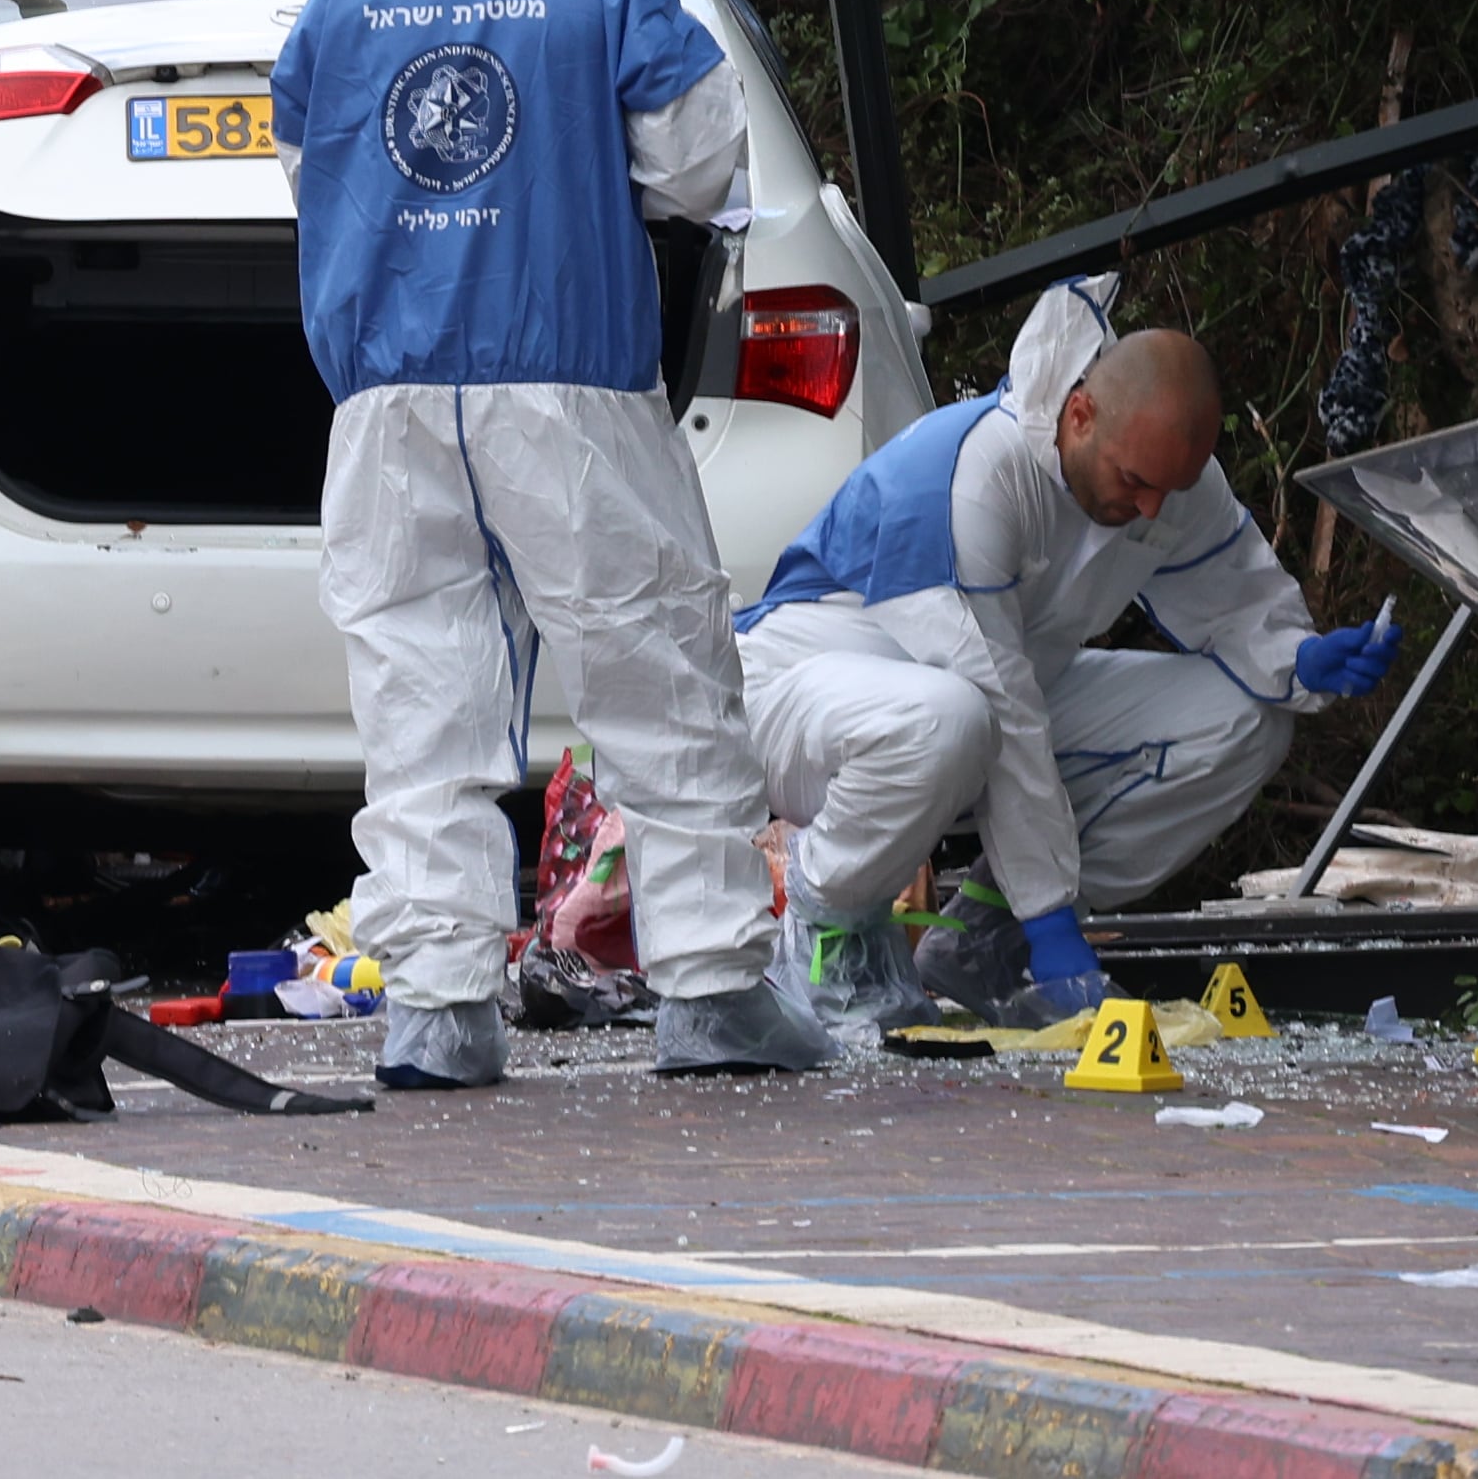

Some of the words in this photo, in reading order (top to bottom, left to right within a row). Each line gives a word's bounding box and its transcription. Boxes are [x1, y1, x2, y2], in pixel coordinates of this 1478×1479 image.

[363, 4, 443, 30] ישראל
[139, 116, 160, 140] IL
[398, 209, 450, 232] פלילי
[455, 207, 500, 228] זיהוי
[1229, 986, 1246, 1018] 5
[1096, 1019, 1127, 1065] 2
[1148, 1029, 1161, 1064] 2
